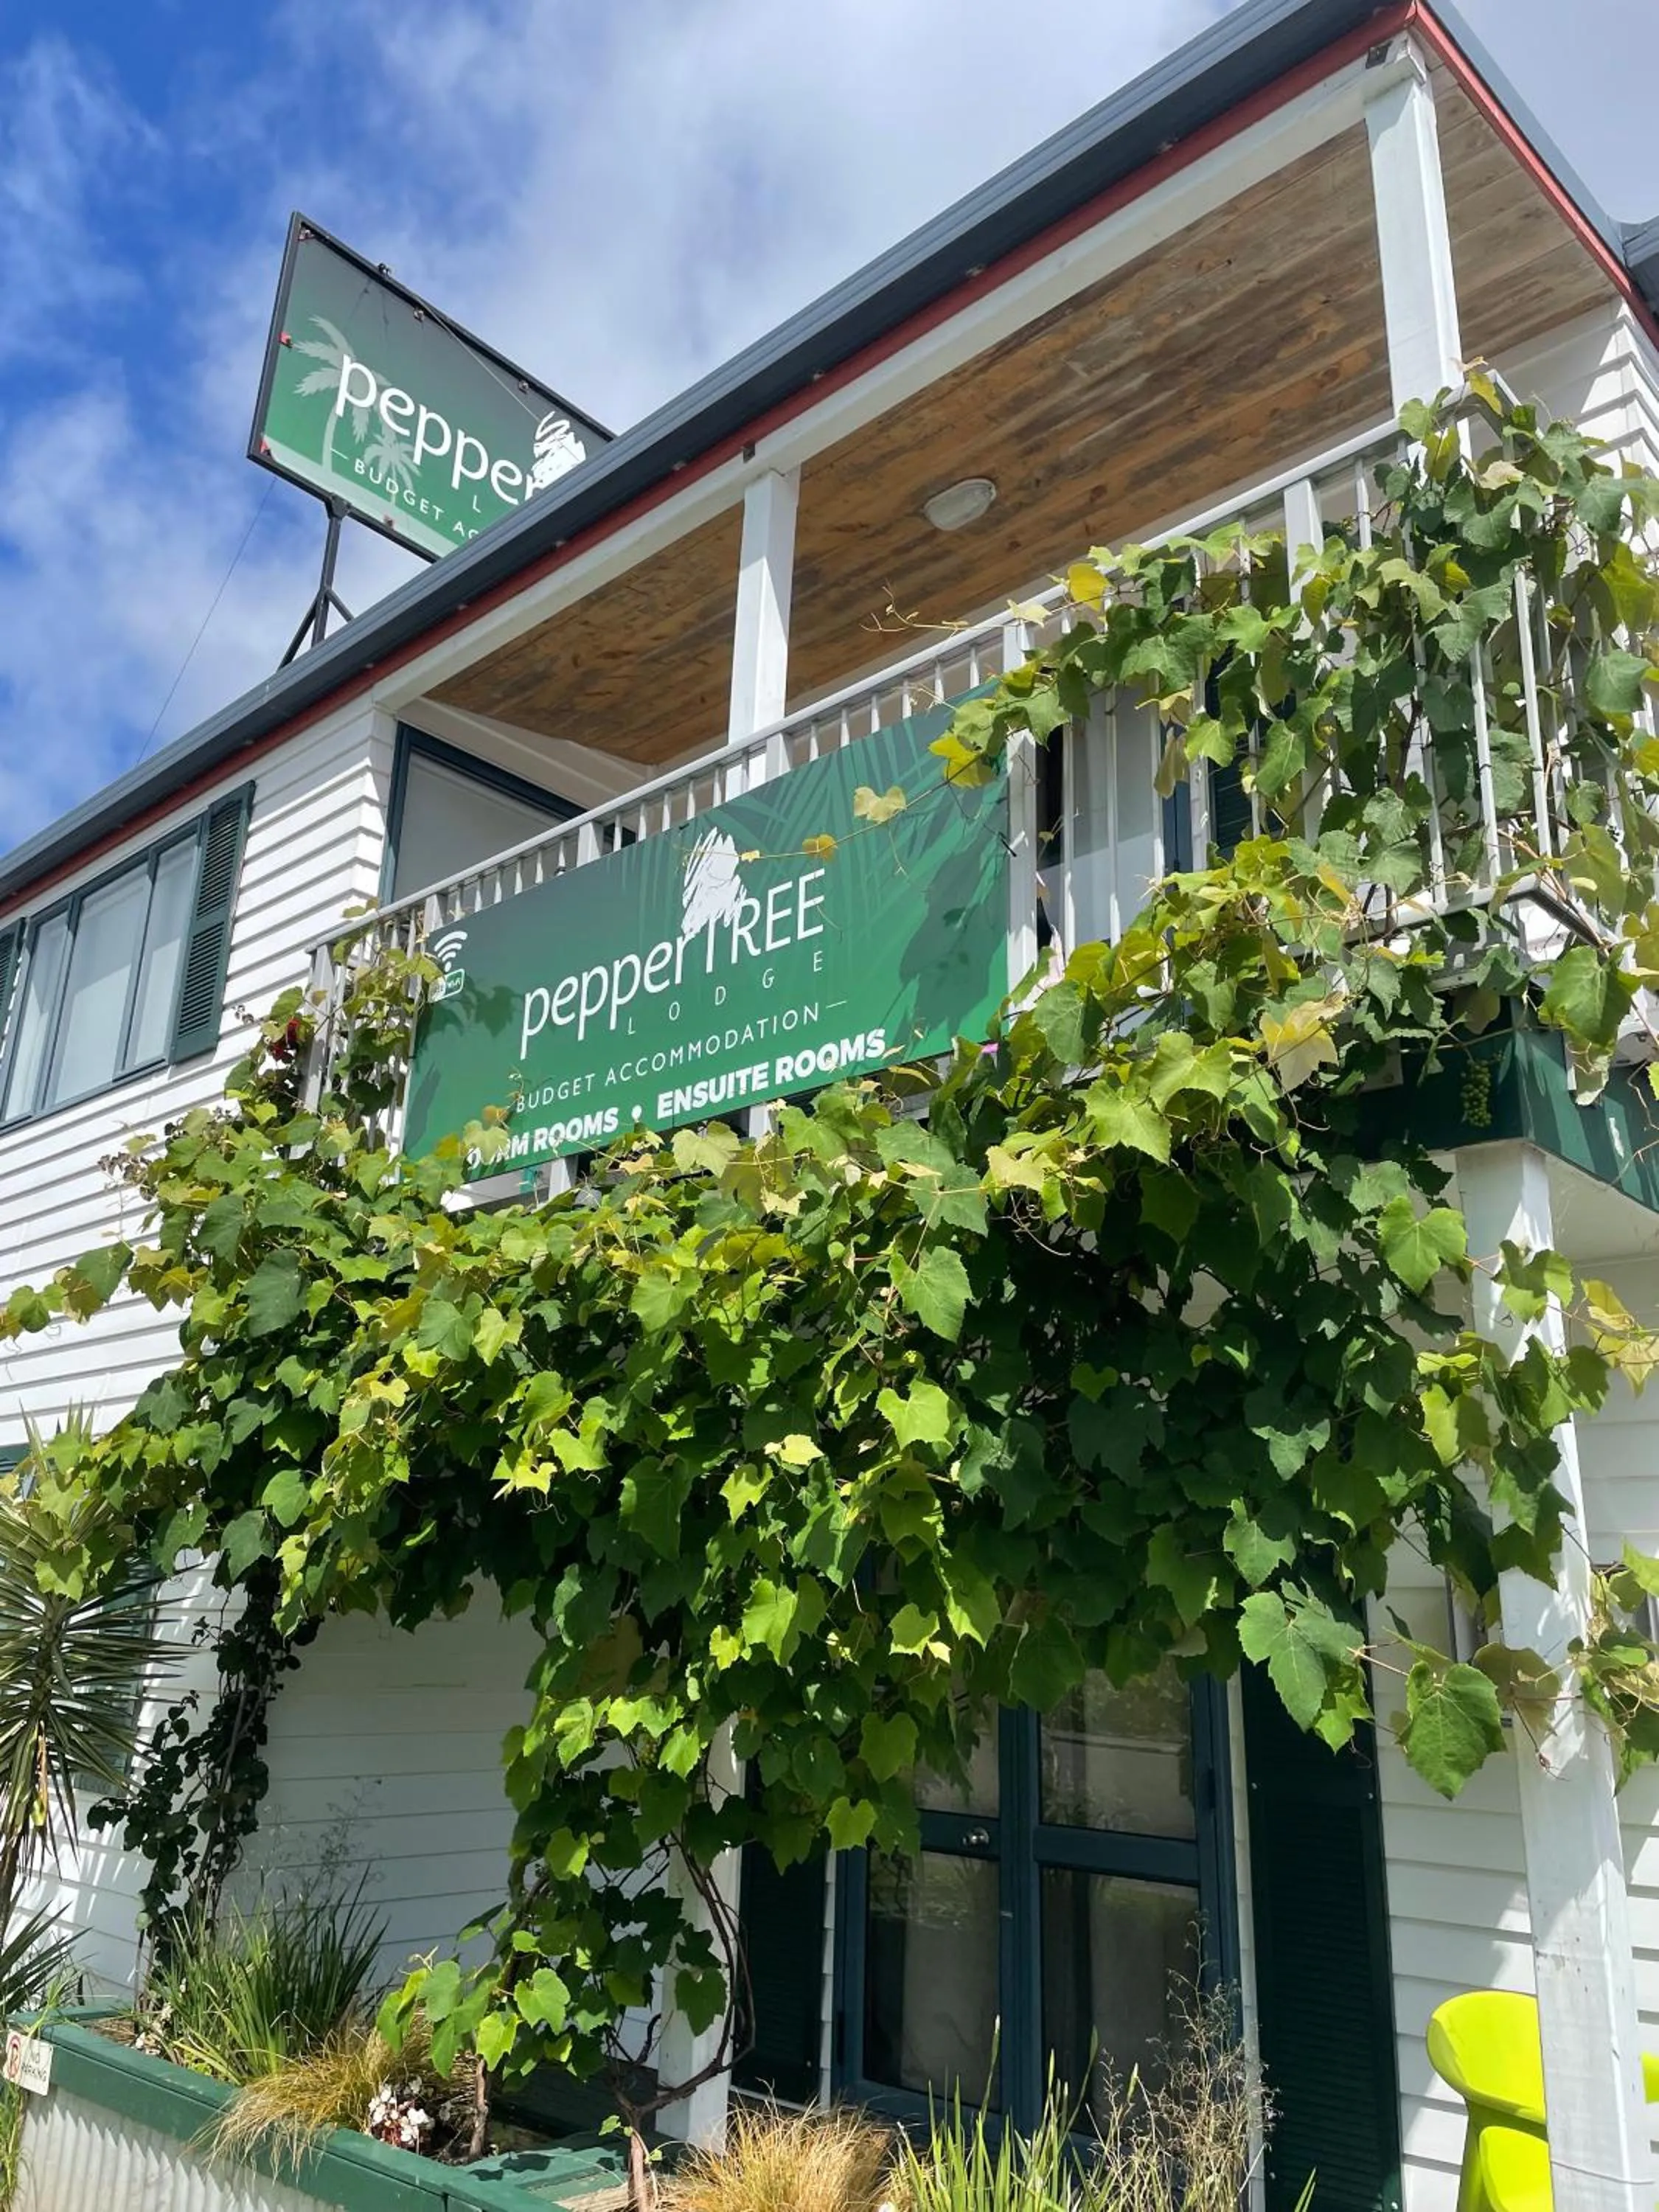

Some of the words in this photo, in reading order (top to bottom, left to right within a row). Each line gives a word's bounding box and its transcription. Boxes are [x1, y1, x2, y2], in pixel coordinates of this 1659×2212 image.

[354, 461, 444, 521] BUDGET
[517, 1074, 595, 1113] BUDGET
[605, 1002, 819, 1087] ACCOMMODATION
[533, 1107, 619, 1152] ROOMS
[657, 1062, 769, 1119] ENSUITE
[775, 1029, 886, 1086] ROOMS
